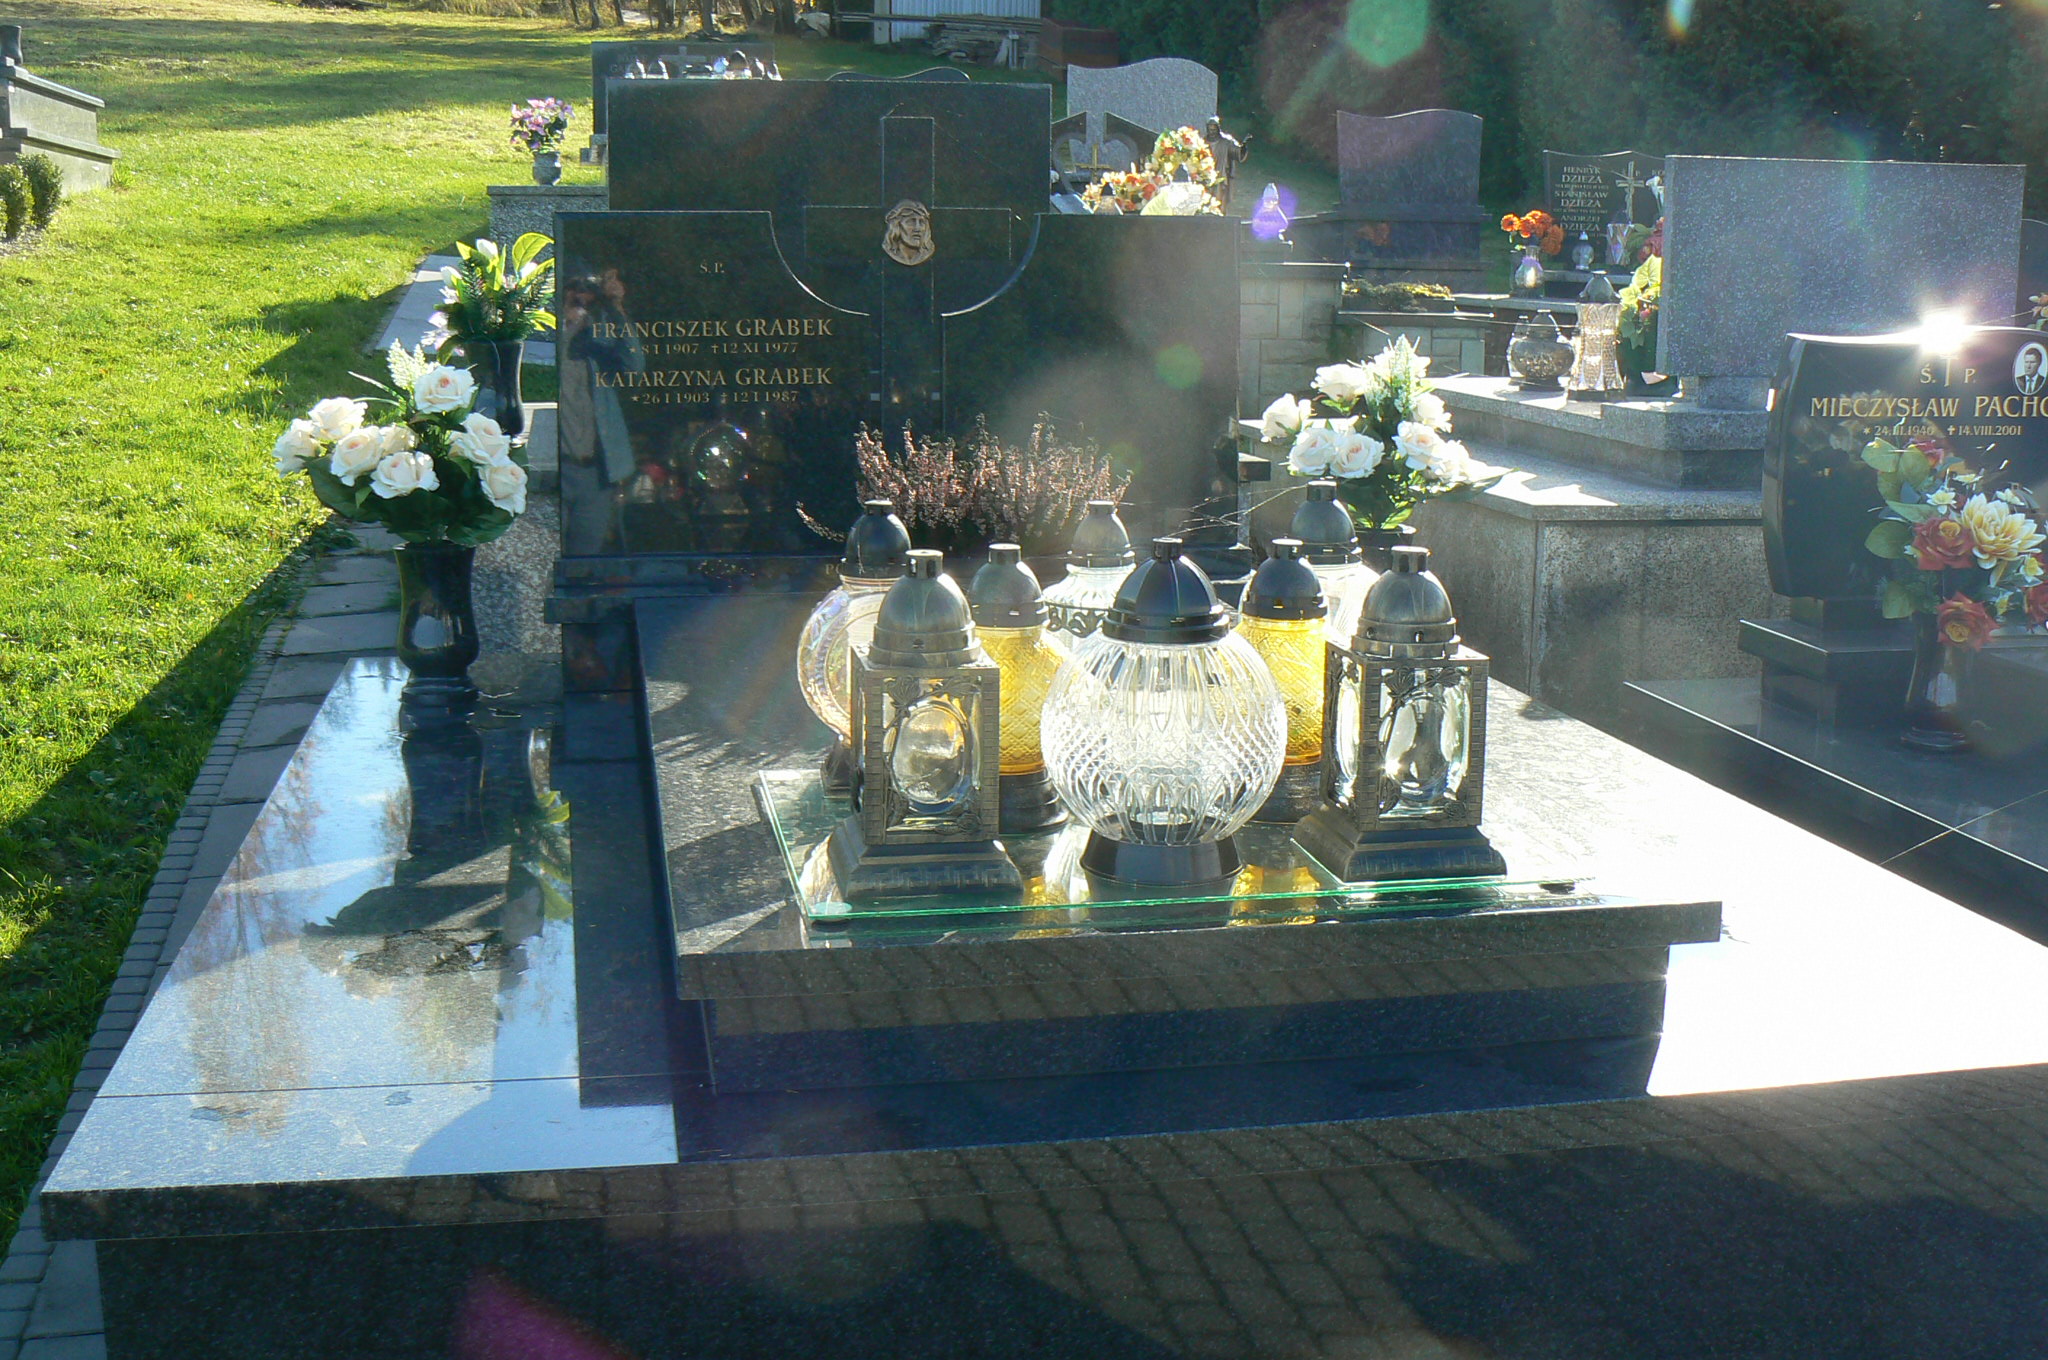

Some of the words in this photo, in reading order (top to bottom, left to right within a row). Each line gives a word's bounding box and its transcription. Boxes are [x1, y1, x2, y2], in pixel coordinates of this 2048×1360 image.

[592, 321, 728, 339] FRANCISZEK
[735, 318, 834, 337] GRABEK
[665, 343, 700, 355] 1907
[765, 342, 799, 354] 1977
[594, 370, 727, 388] KATARZYNA
[735, 367, 833, 386] GRABEK
[675, 392, 710, 404] 1903
[764, 390, 799, 403] 1987
[1810, 397, 1960, 418] MIECZYSŁAW
